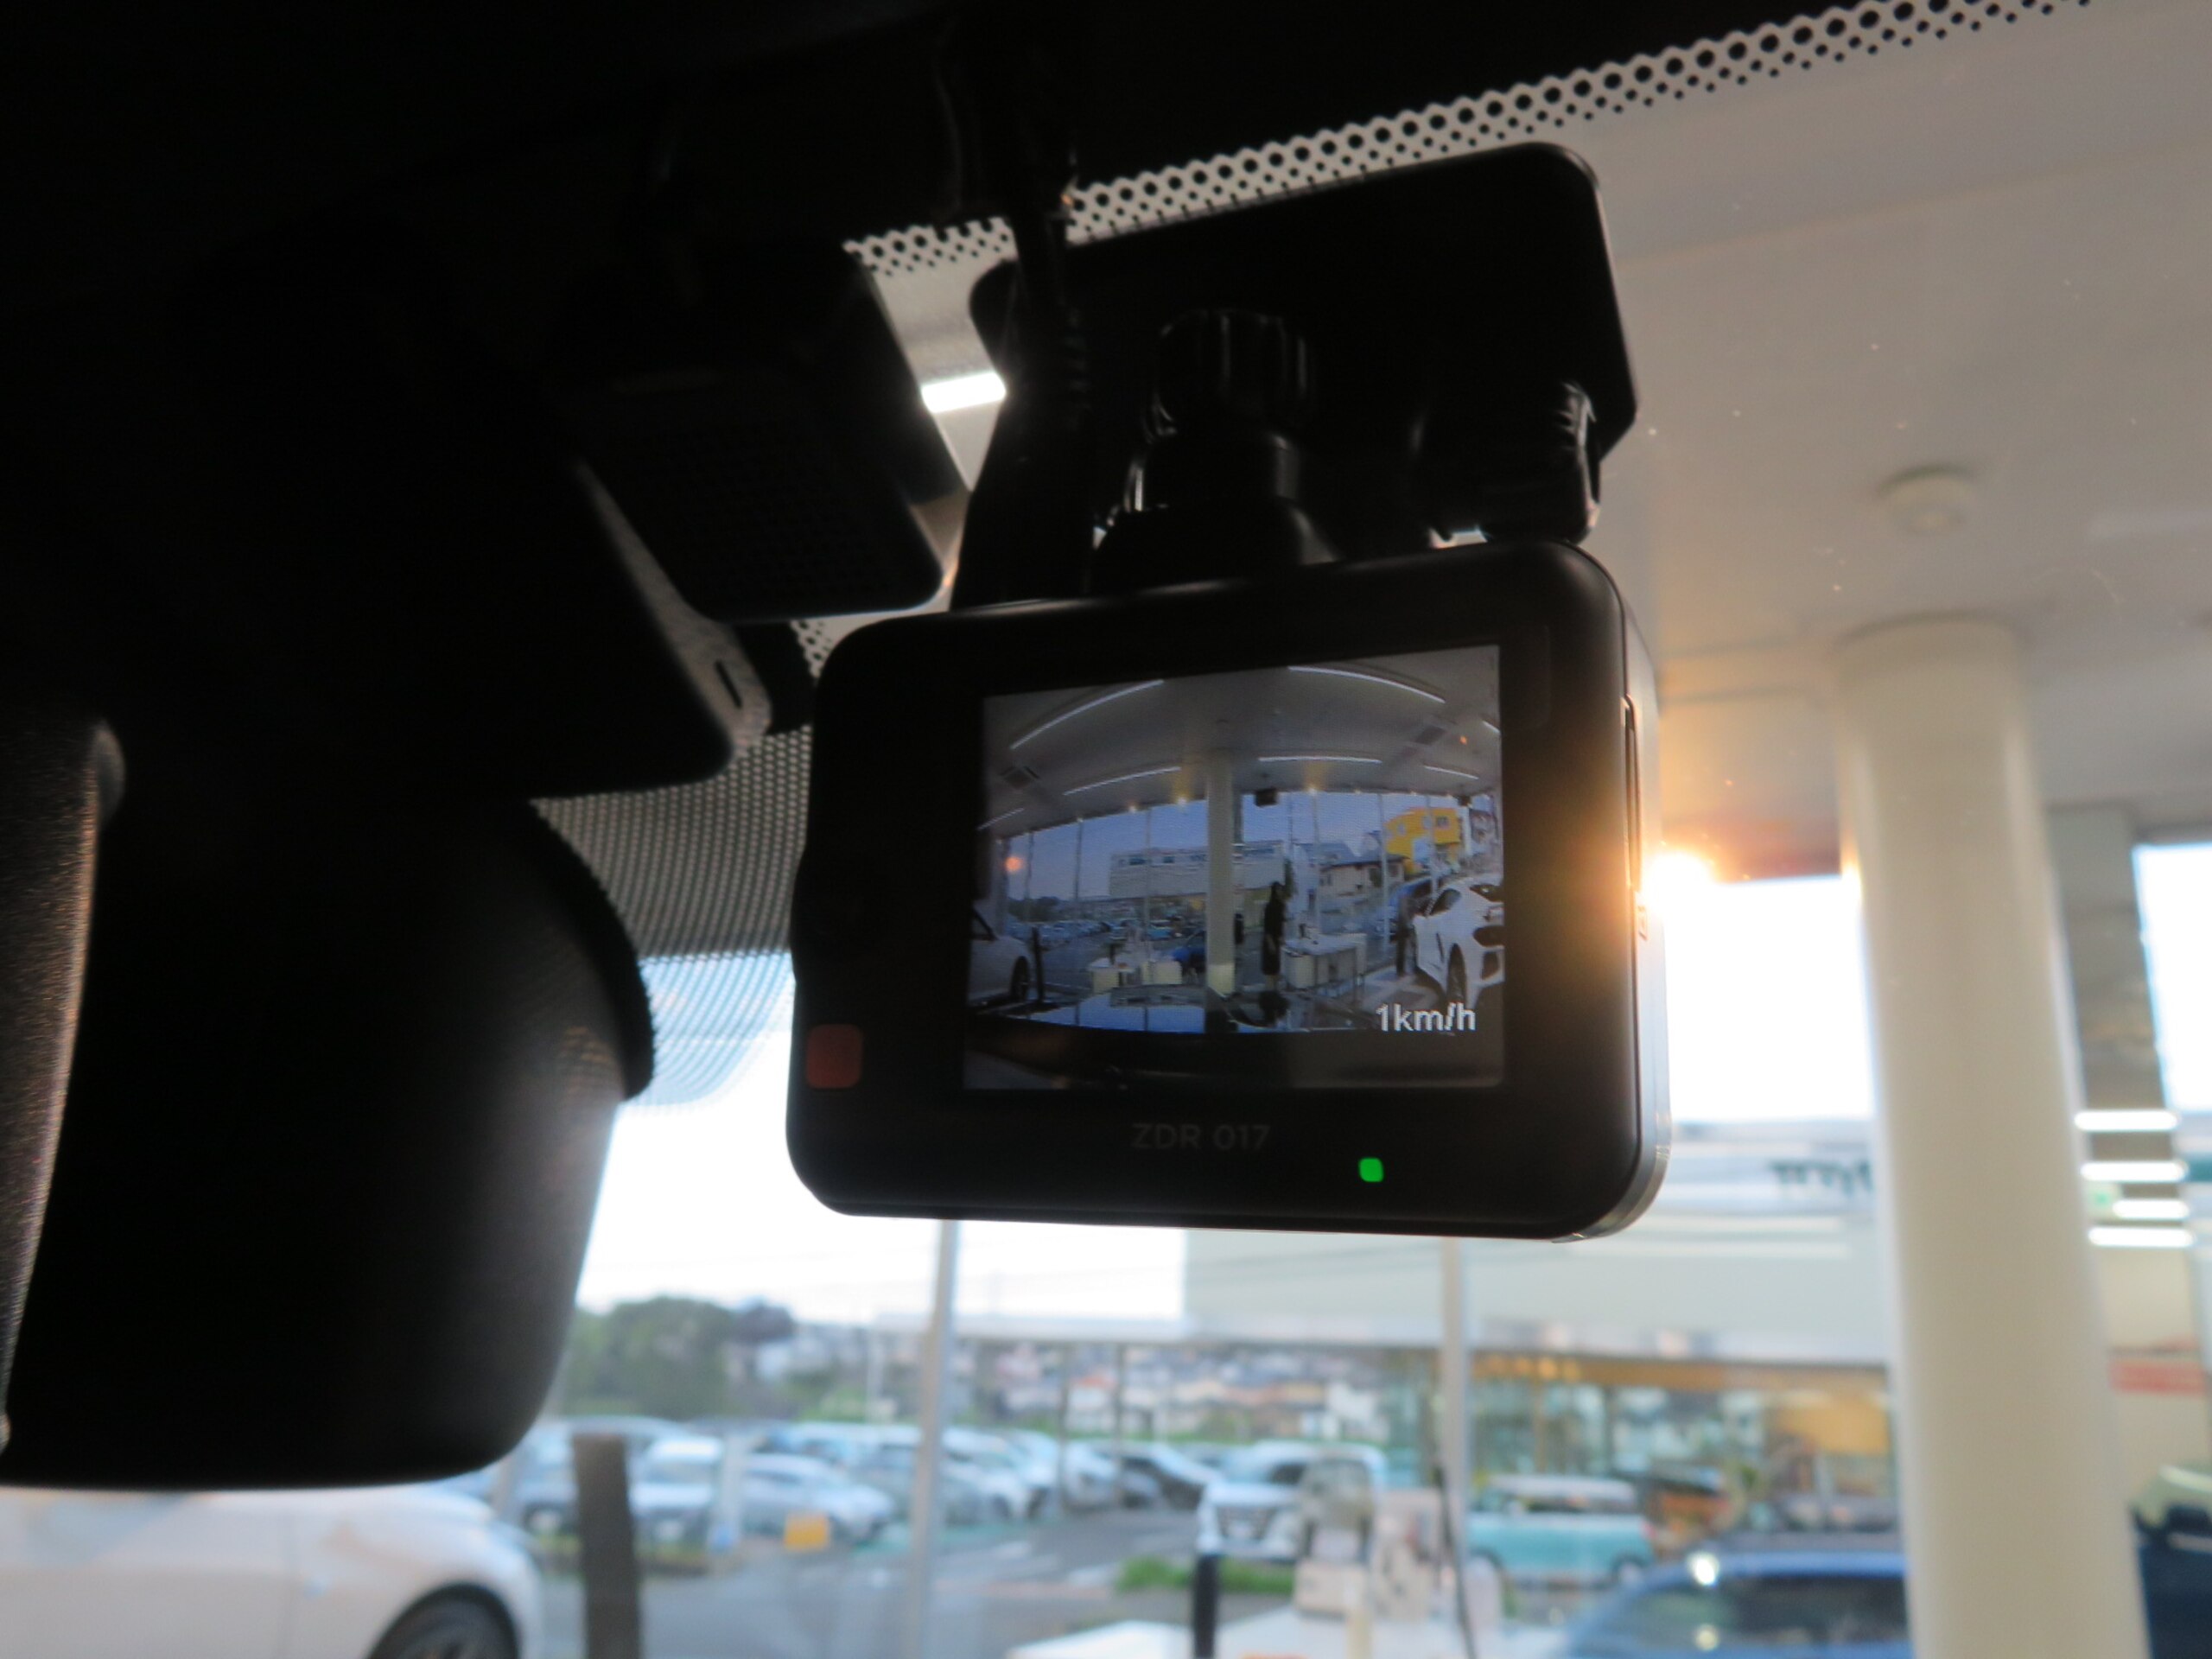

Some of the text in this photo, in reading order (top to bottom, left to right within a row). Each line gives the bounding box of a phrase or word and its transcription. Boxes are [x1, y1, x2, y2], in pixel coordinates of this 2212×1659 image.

[1375, 1002, 1477, 1032] 1km/h
[1130, 1123, 1271, 1151] ZDR 017
